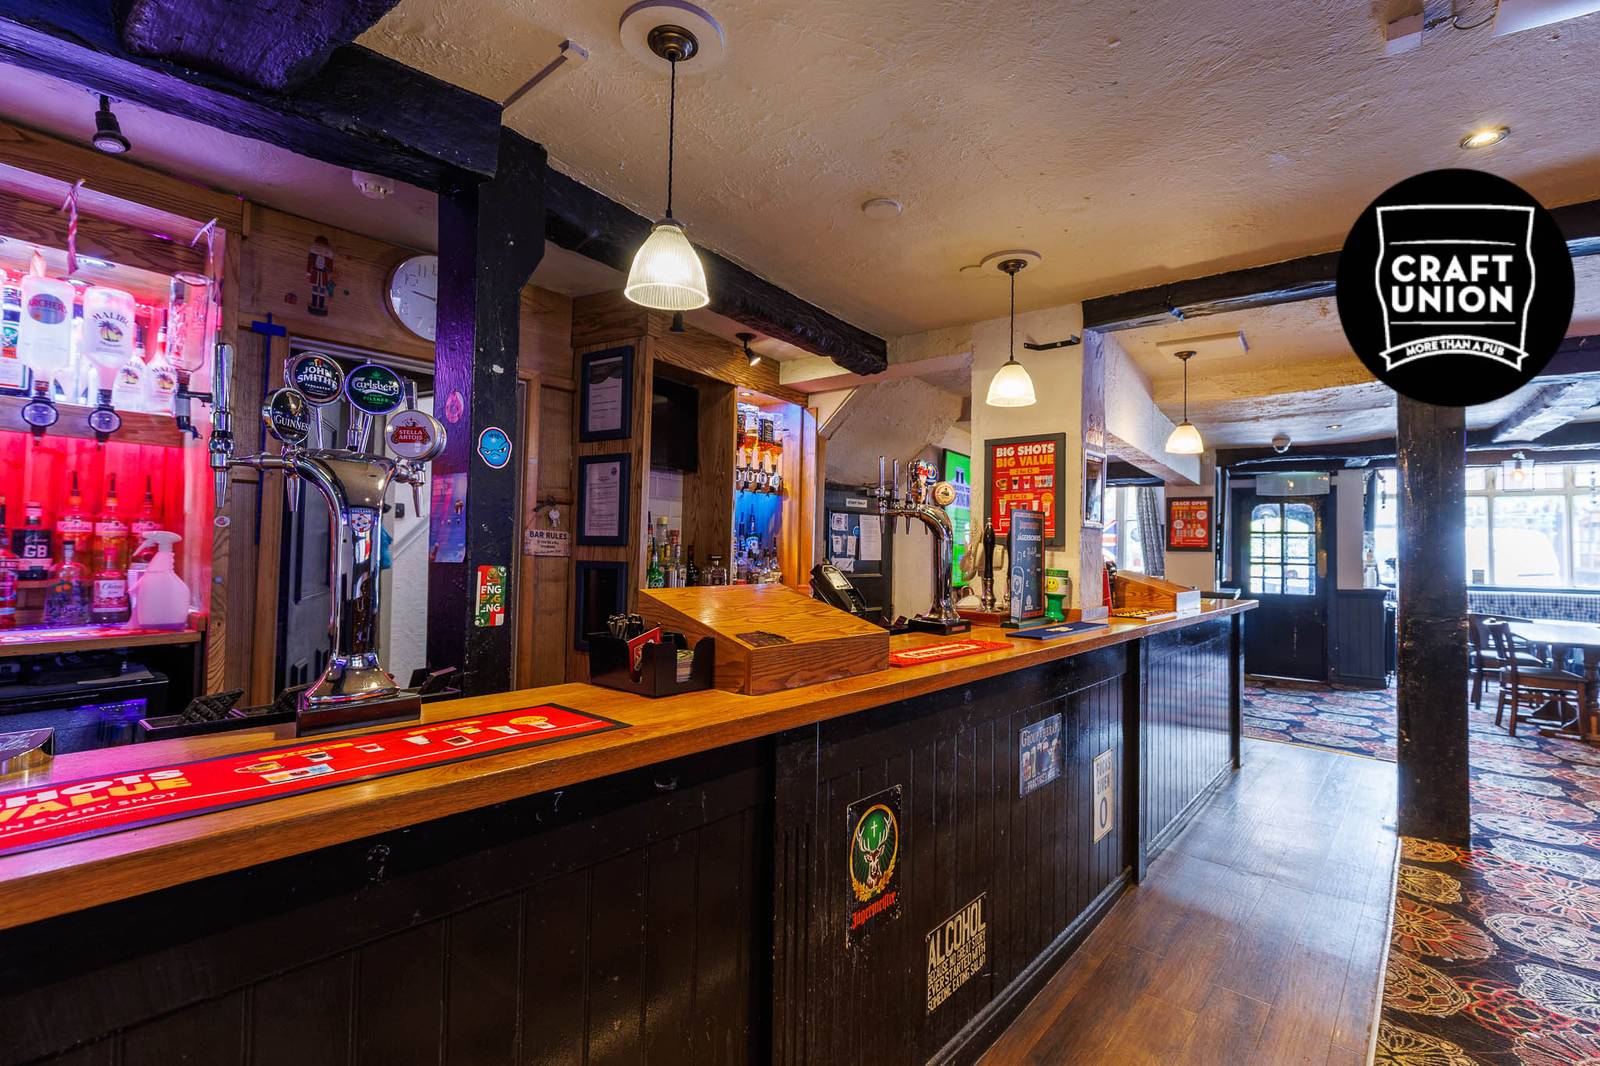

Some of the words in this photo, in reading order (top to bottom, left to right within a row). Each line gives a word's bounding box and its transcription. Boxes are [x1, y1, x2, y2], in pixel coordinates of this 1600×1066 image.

[302, 366, 332, 378] JOHN
[352, 377, 399, 395] Carlsberg
[996, 446, 1015, 458] BIG
[1017, 443, 1055, 456] SHOTS
[995, 457, 1016, 468] BIG
[1019, 454, 1054, 466] VALUE
[529, 531, 544, 539] BAR
[545, 532, 568, 540] RULES
[23, 544, 48, 558] GB
[481, 585, 502, 595] ENG
[0, 768, 185, 809] HOTS
[33, 802, 112, 825] EVERY
[118, 791, 178, 806] SHOT
[927, 899, 987, 974] ALCOHOL
[927, 977, 945, 1001] EVER
[944, 952, 972, 985] STARTED
[972, 940, 986, 961] WITH
